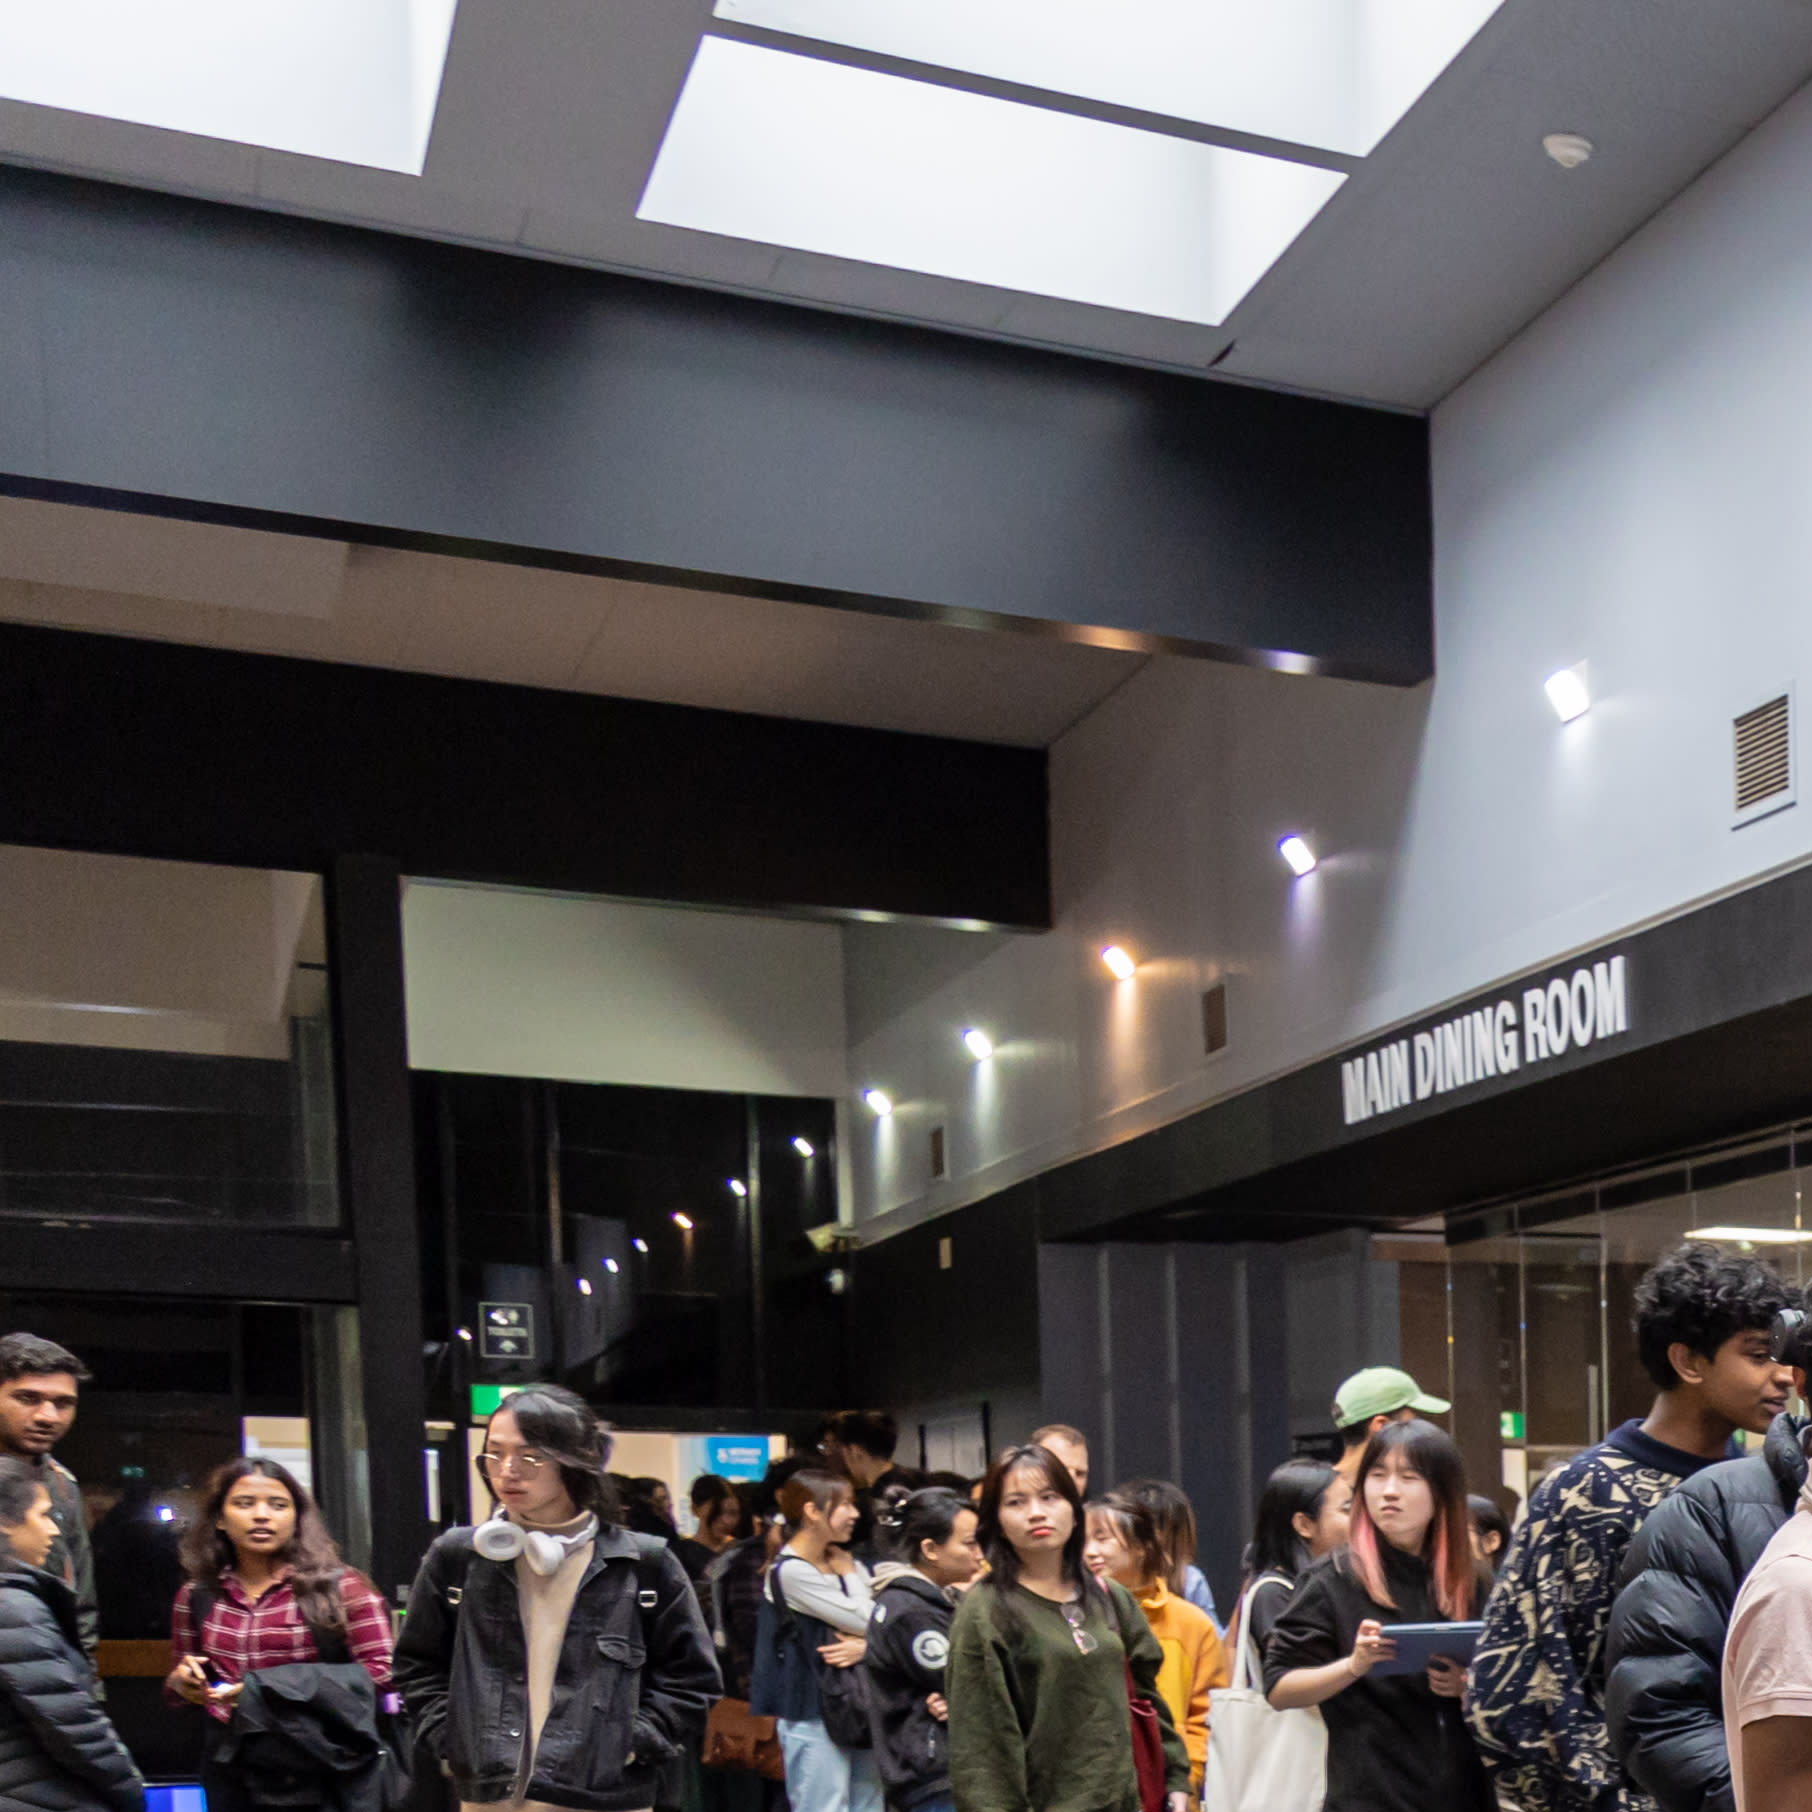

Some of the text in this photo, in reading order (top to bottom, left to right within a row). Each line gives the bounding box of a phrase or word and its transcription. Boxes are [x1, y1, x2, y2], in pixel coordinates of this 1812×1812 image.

[1341, 954, 1628, 1125] MAIN DINING ROOM
